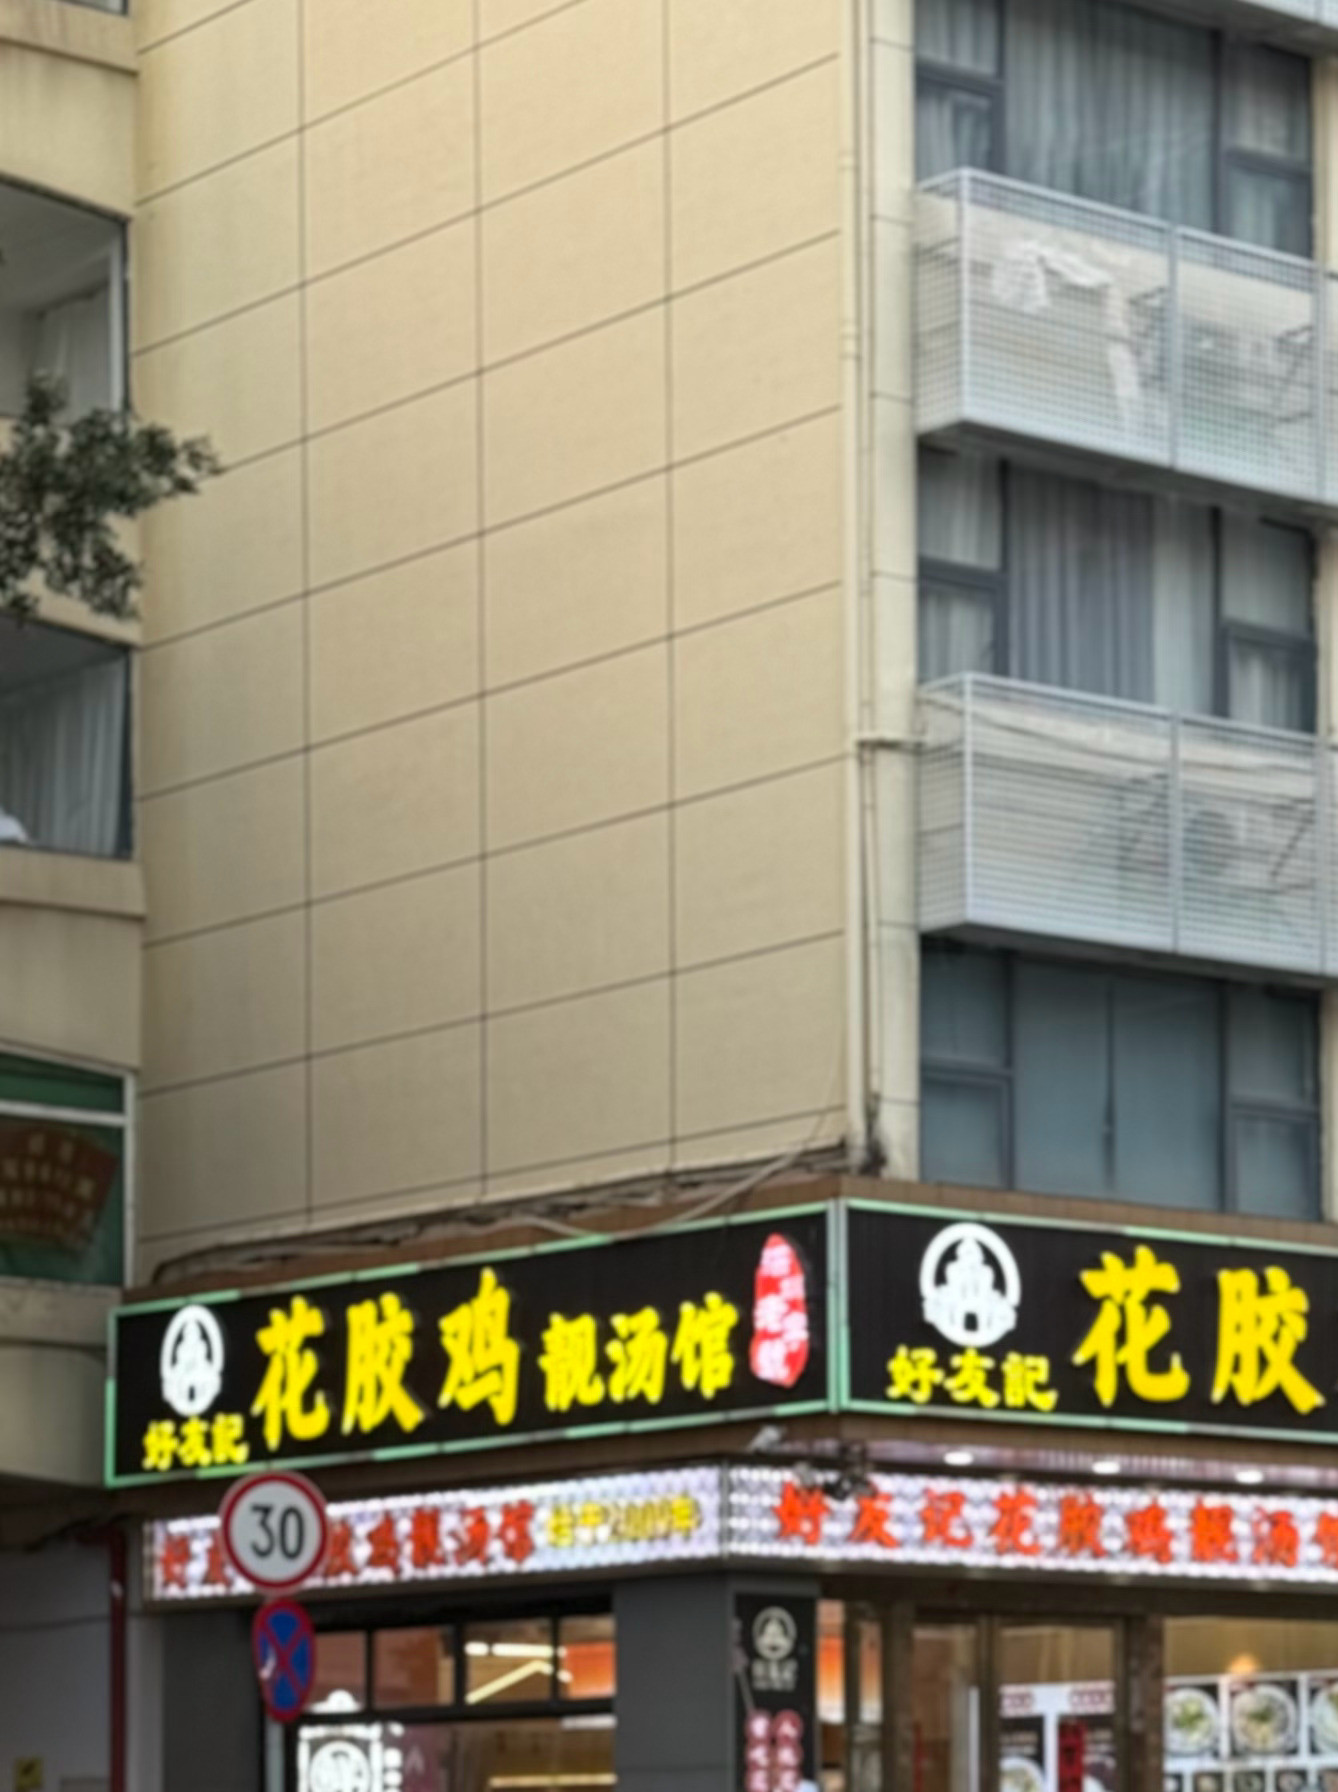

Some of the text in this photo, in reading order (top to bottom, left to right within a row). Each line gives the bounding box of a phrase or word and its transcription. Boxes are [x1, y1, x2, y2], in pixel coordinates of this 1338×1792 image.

[252, 1267, 739, 1450] 花胶鸡靓汤馆
[251, 1504, 306, 1561] 30
